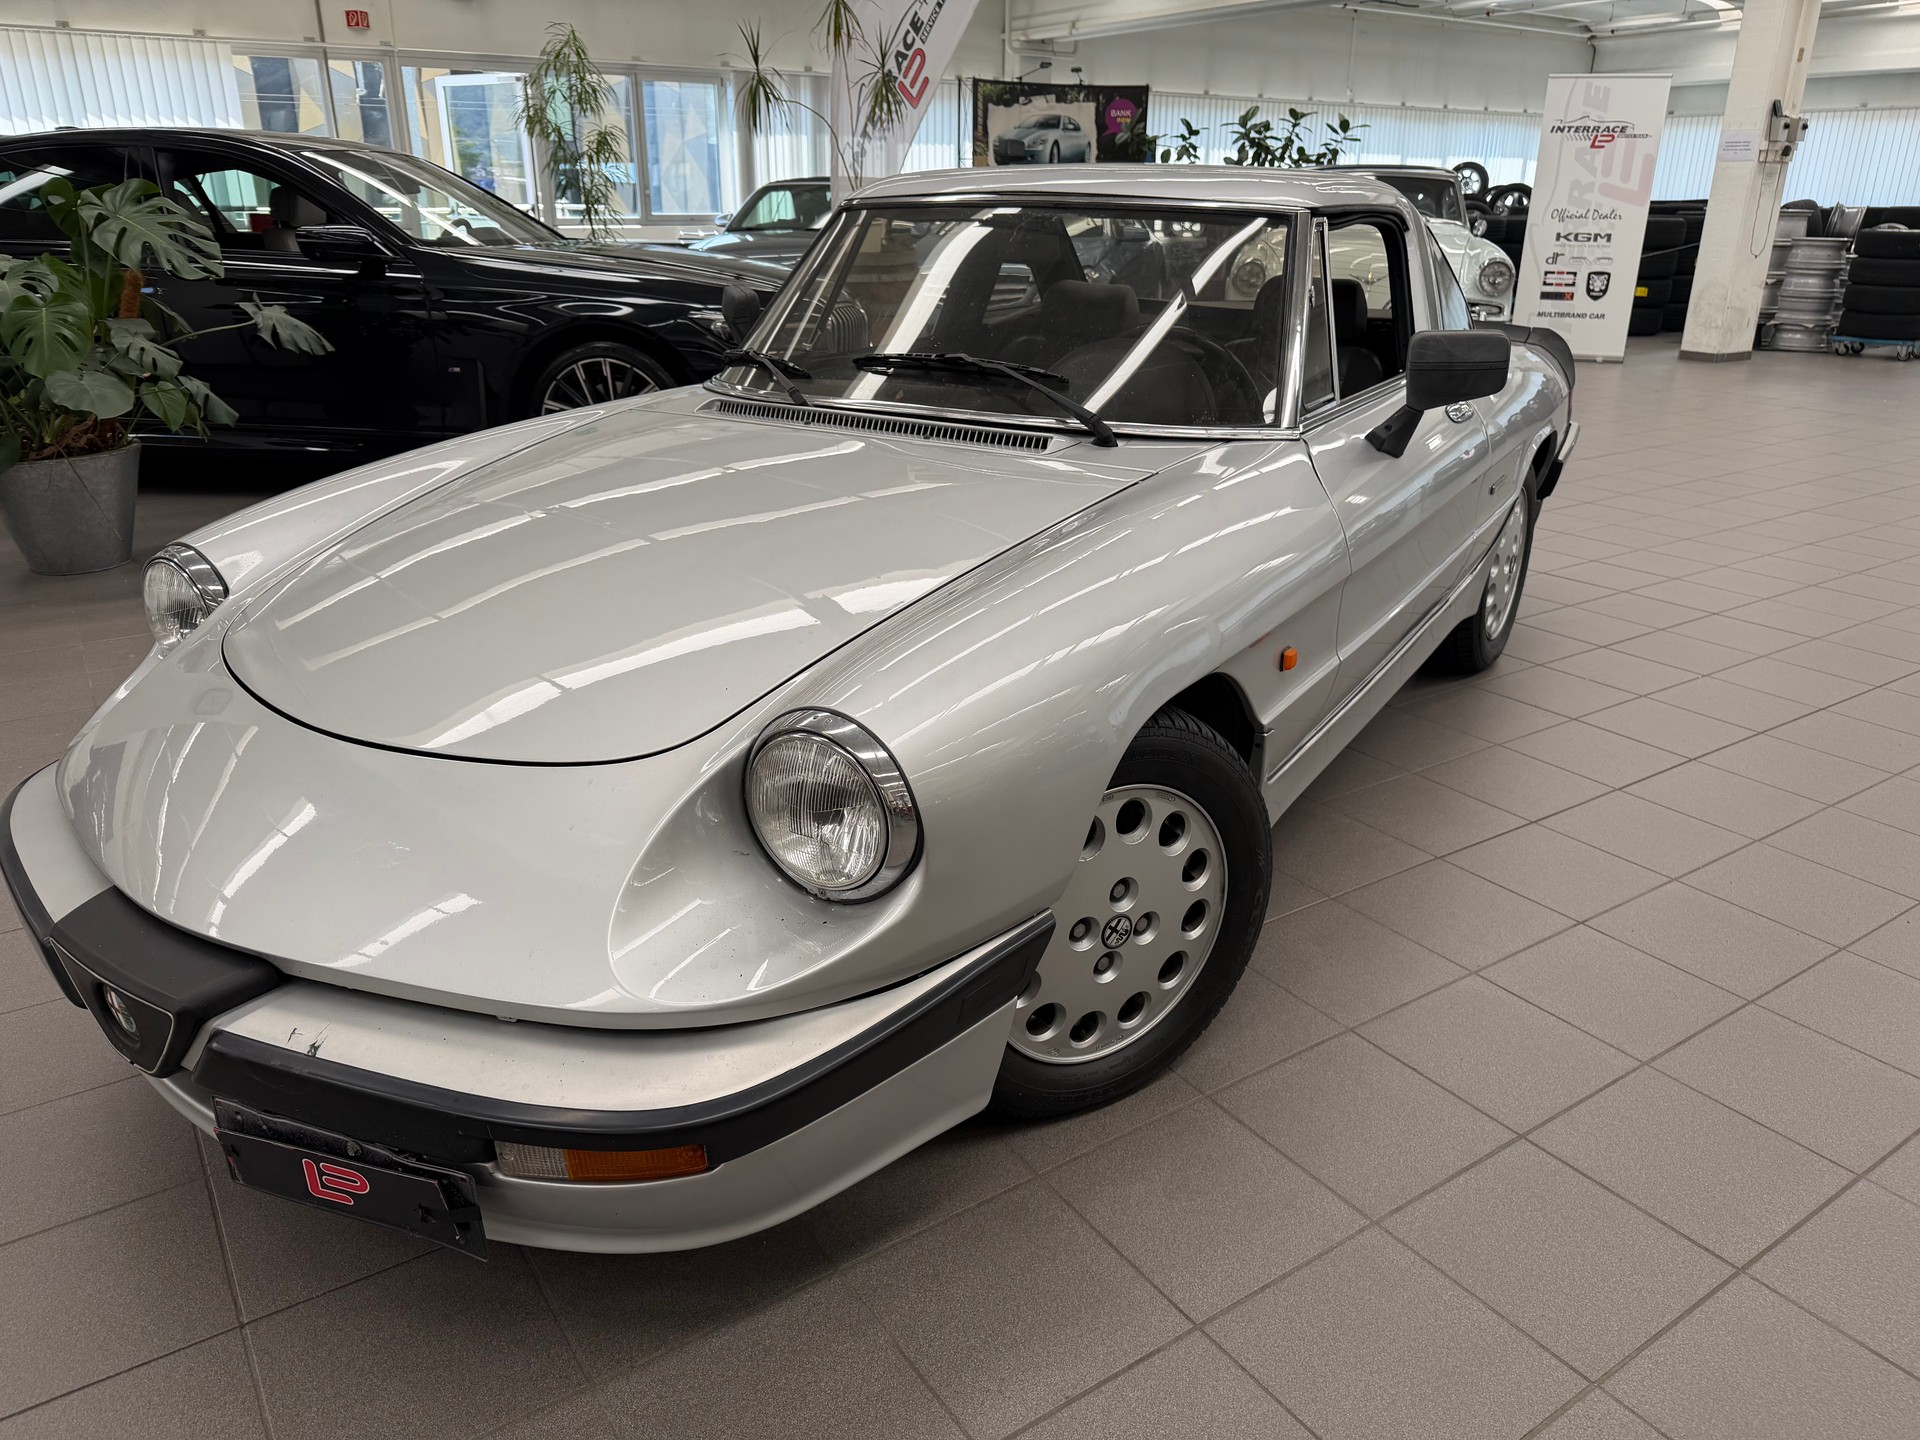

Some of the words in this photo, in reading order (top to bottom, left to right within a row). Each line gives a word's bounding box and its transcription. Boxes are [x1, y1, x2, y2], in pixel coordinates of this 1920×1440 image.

[1110, 108, 1132, 117] BANK
[1550, 125, 1629, 134] INTERRACE
[1550, 207, 1590, 223] Official
[1591, 208, 1623, 221] Dealer
[1555, 232, 1612, 243] KGM
[1536, 311, 1588, 319] MULTIBRAND
[1588, 312, 1606, 320] CAR
